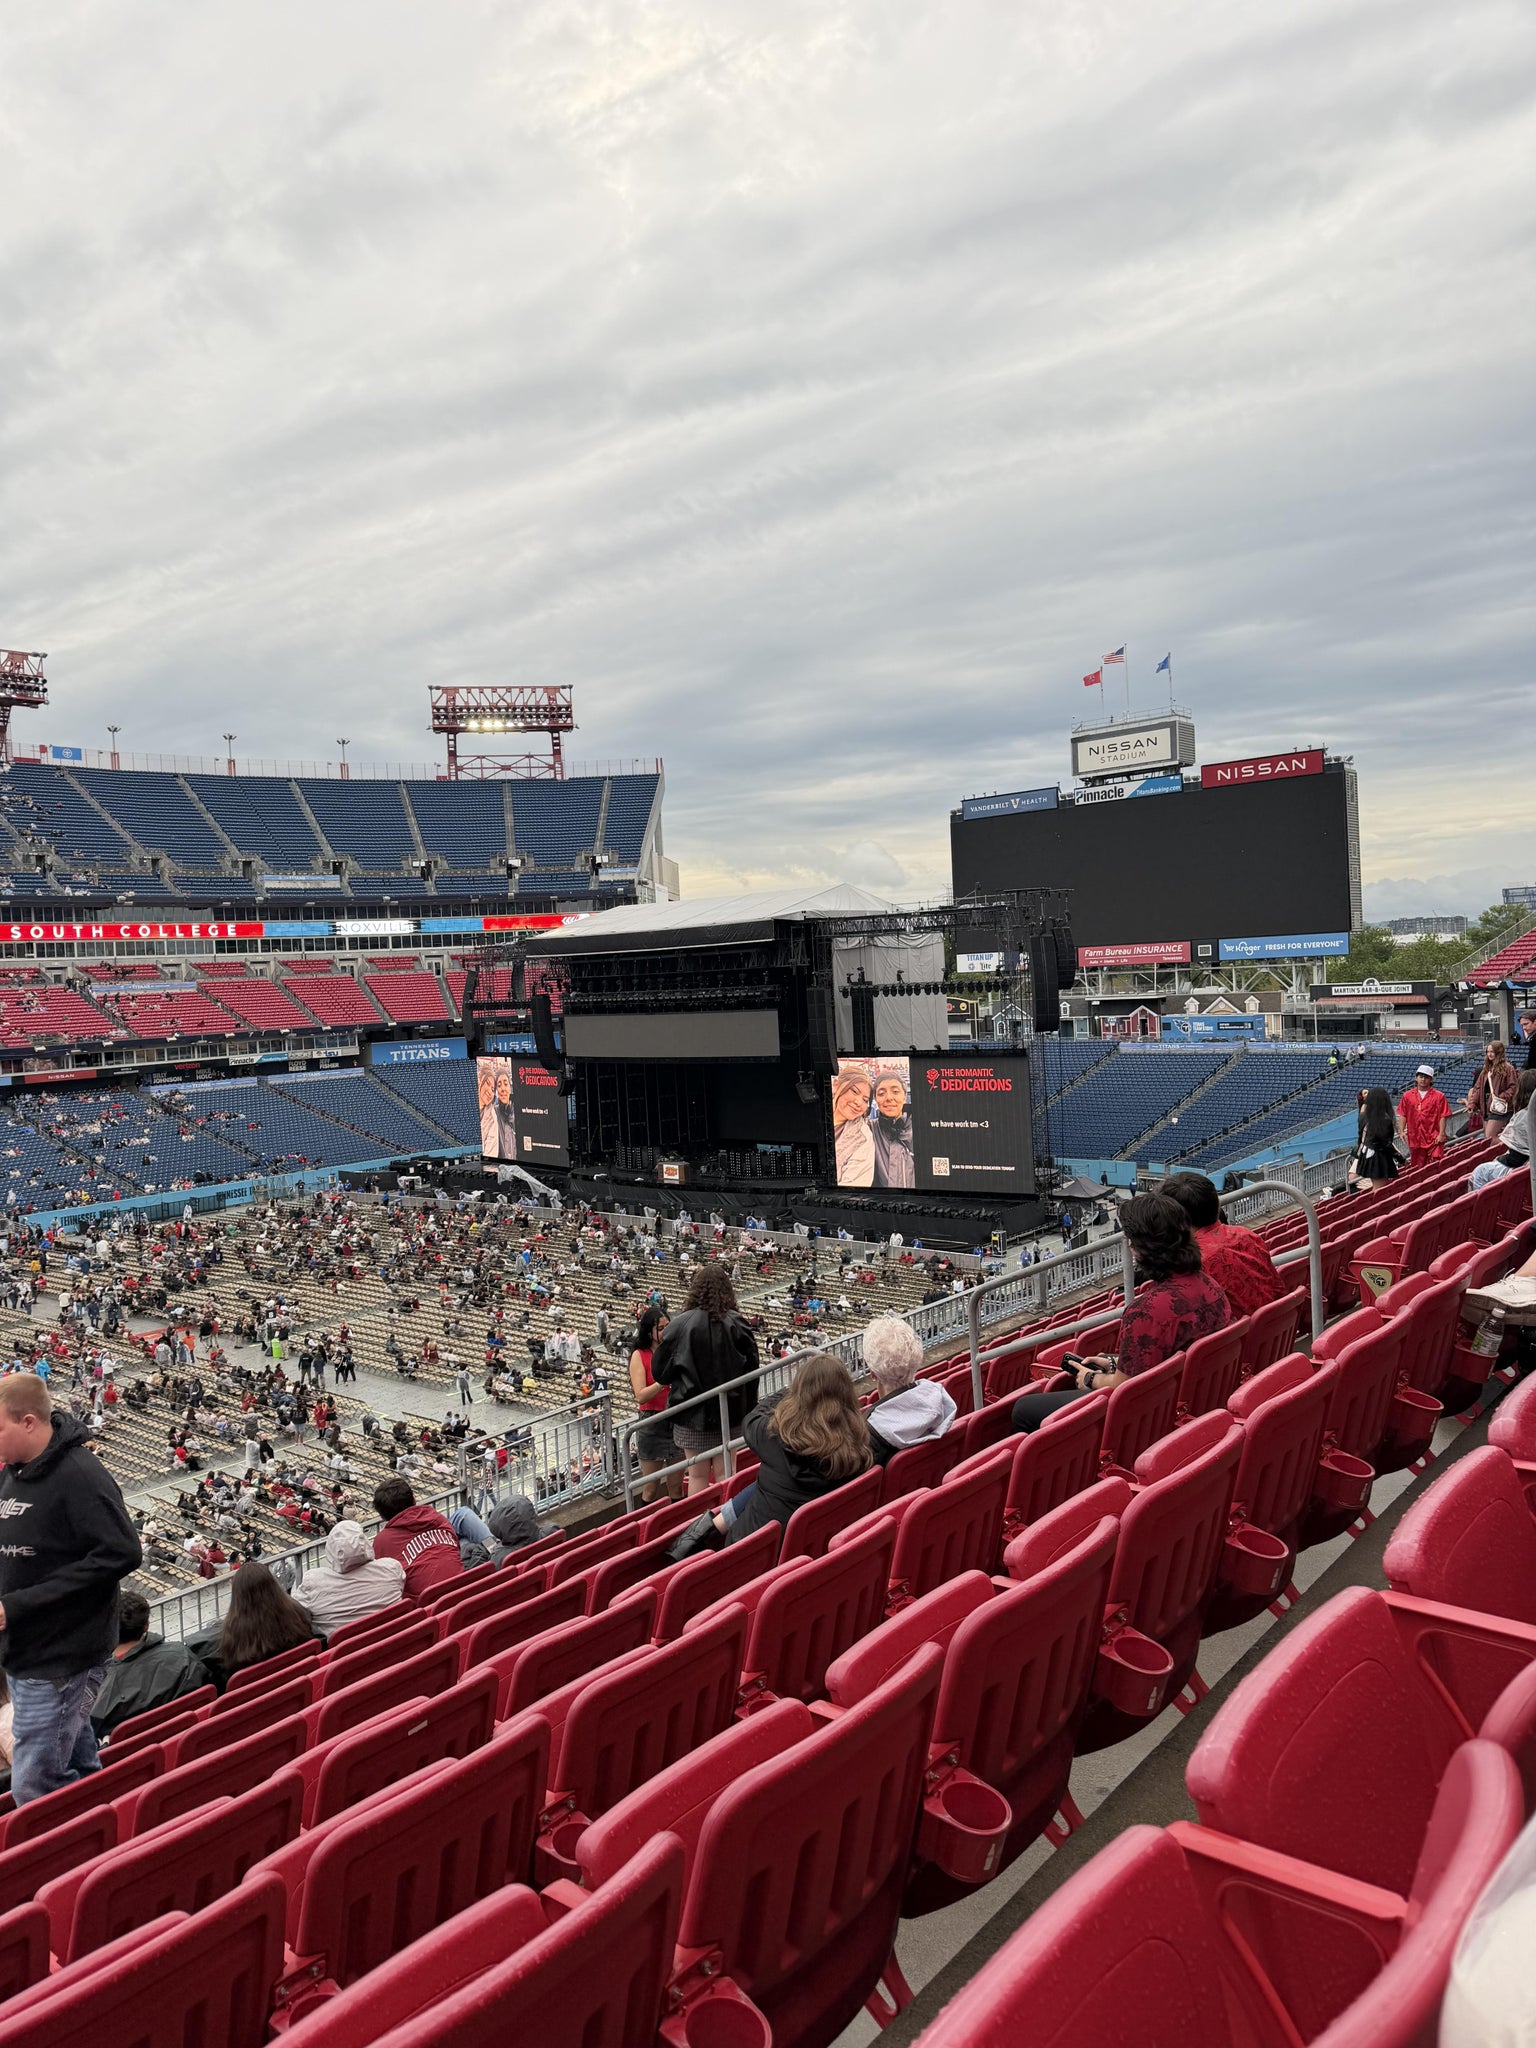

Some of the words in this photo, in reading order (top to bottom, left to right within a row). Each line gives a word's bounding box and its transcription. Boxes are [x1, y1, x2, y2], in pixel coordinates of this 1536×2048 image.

[1089, 736, 1158, 756] NISSAN
[1100, 751, 1147, 764] STADIUM
[1217, 757, 1306, 781] NISSAN
[1076, 786, 1124, 803] Pinnacle
[970, 801, 1010, 812] VANDERBILT
[1021, 796, 1048, 805] HEALTH
[10, 925, 104, 939] SOUTH
[119, 924, 237, 938] COLLEGE
[1084, 949, 1103, 957] Farm
[1105, 947, 1132, 956] Bureau
[1133, 944, 1183, 954] INSURANCE
[1235, 941, 1261, 956] Kroger
[1265, 943, 1286, 951] FRESH
[390, 1047, 451, 1061] TITANS
[174, 1062, 200, 1070] verizon
[230, 1057, 254, 1065] Pinnacle
[940, 1068, 954, 1077] THE
[955, 1068, 994, 1077] ROMANTIC
[153, 1075, 182, 1084] JOHNSON
[525, 1075, 558, 1087] DEDICATIONS
[940, 1078, 1013, 1091] DEDICATIONS
[940, 1119, 954, 1128] have
[955, 1120, 970, 1128] work
[979, 1120, 989, 1128] <3
